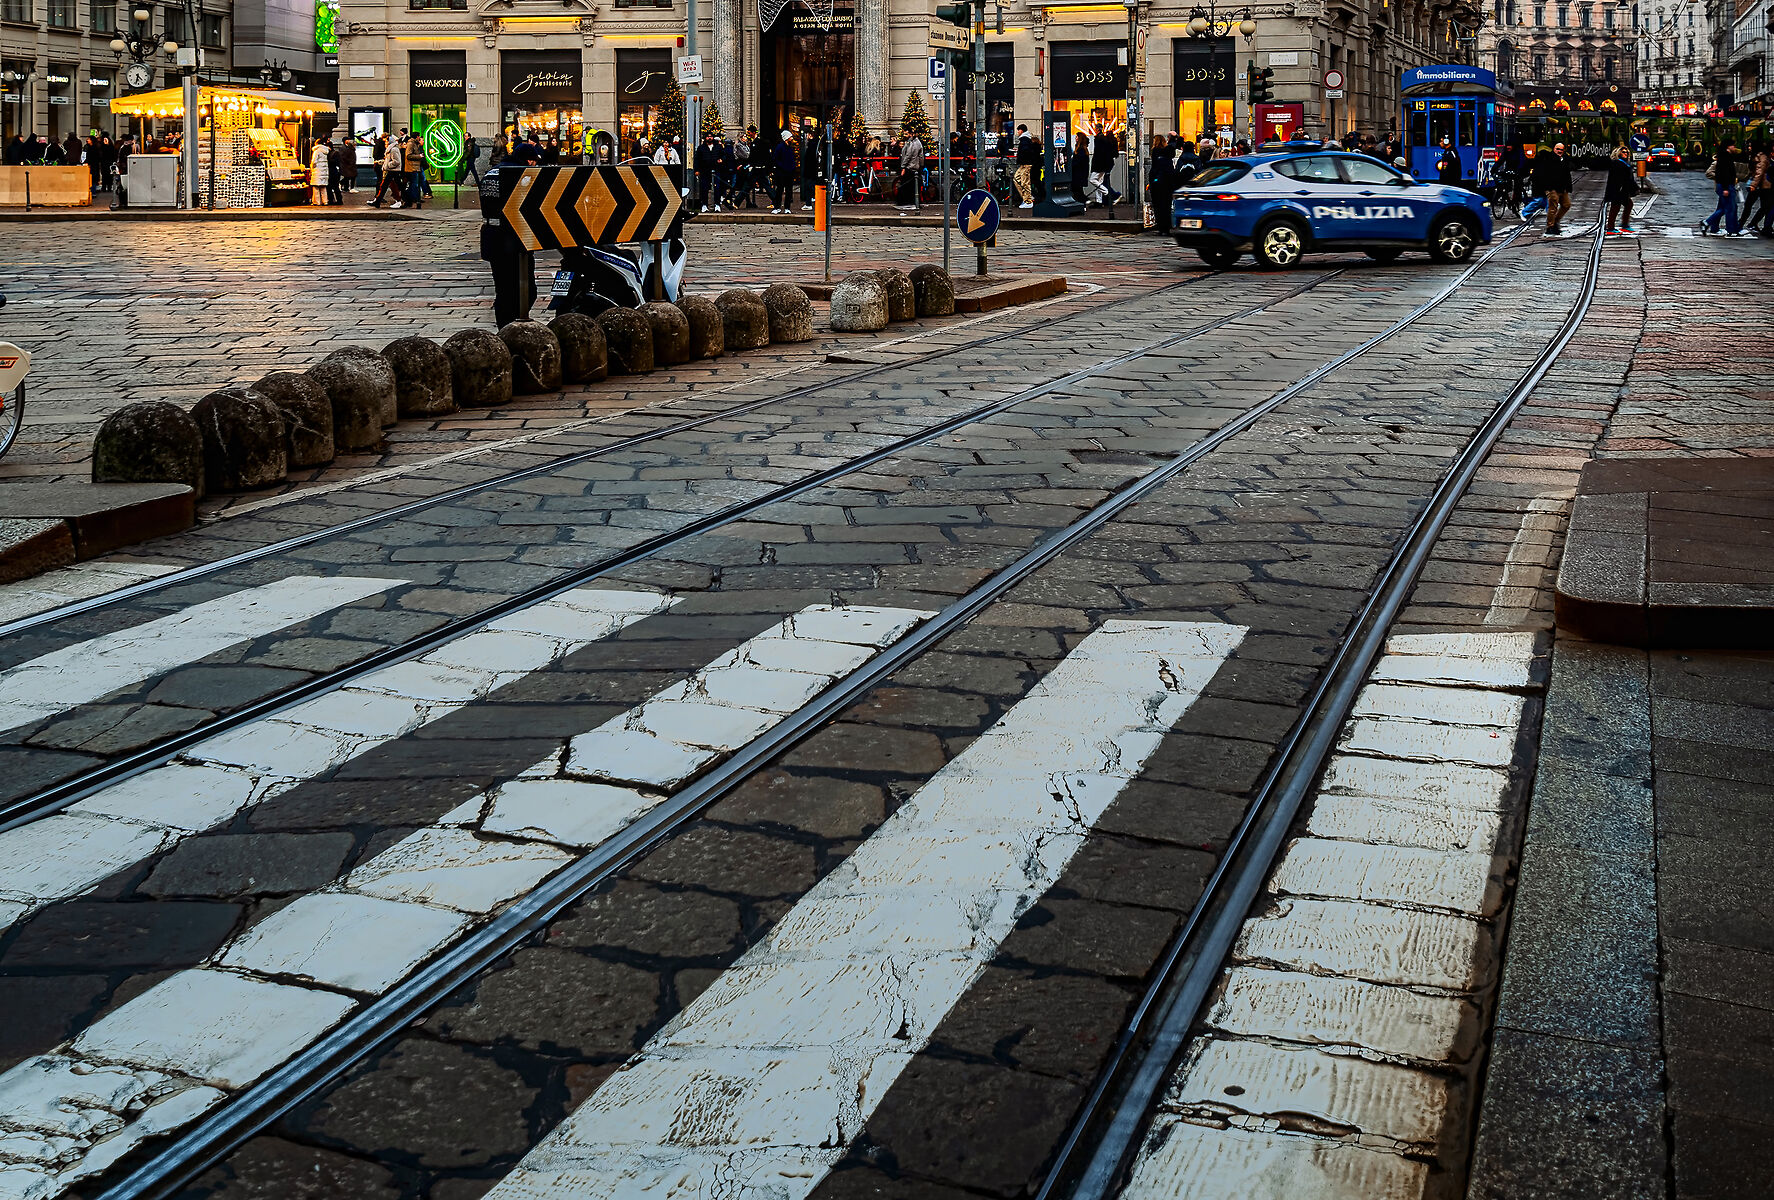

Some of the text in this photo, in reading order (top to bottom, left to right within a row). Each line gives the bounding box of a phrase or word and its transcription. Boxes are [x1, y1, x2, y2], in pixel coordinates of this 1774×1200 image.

[934, 60, 945, 76] P
[415, 79, 463, 88] SWAROVSKI
[1075, 70, 1113, 84] BOSS
[1415, 100, 1425, 111] 19
[1312, 205, 1414, 220] POLIZIA
